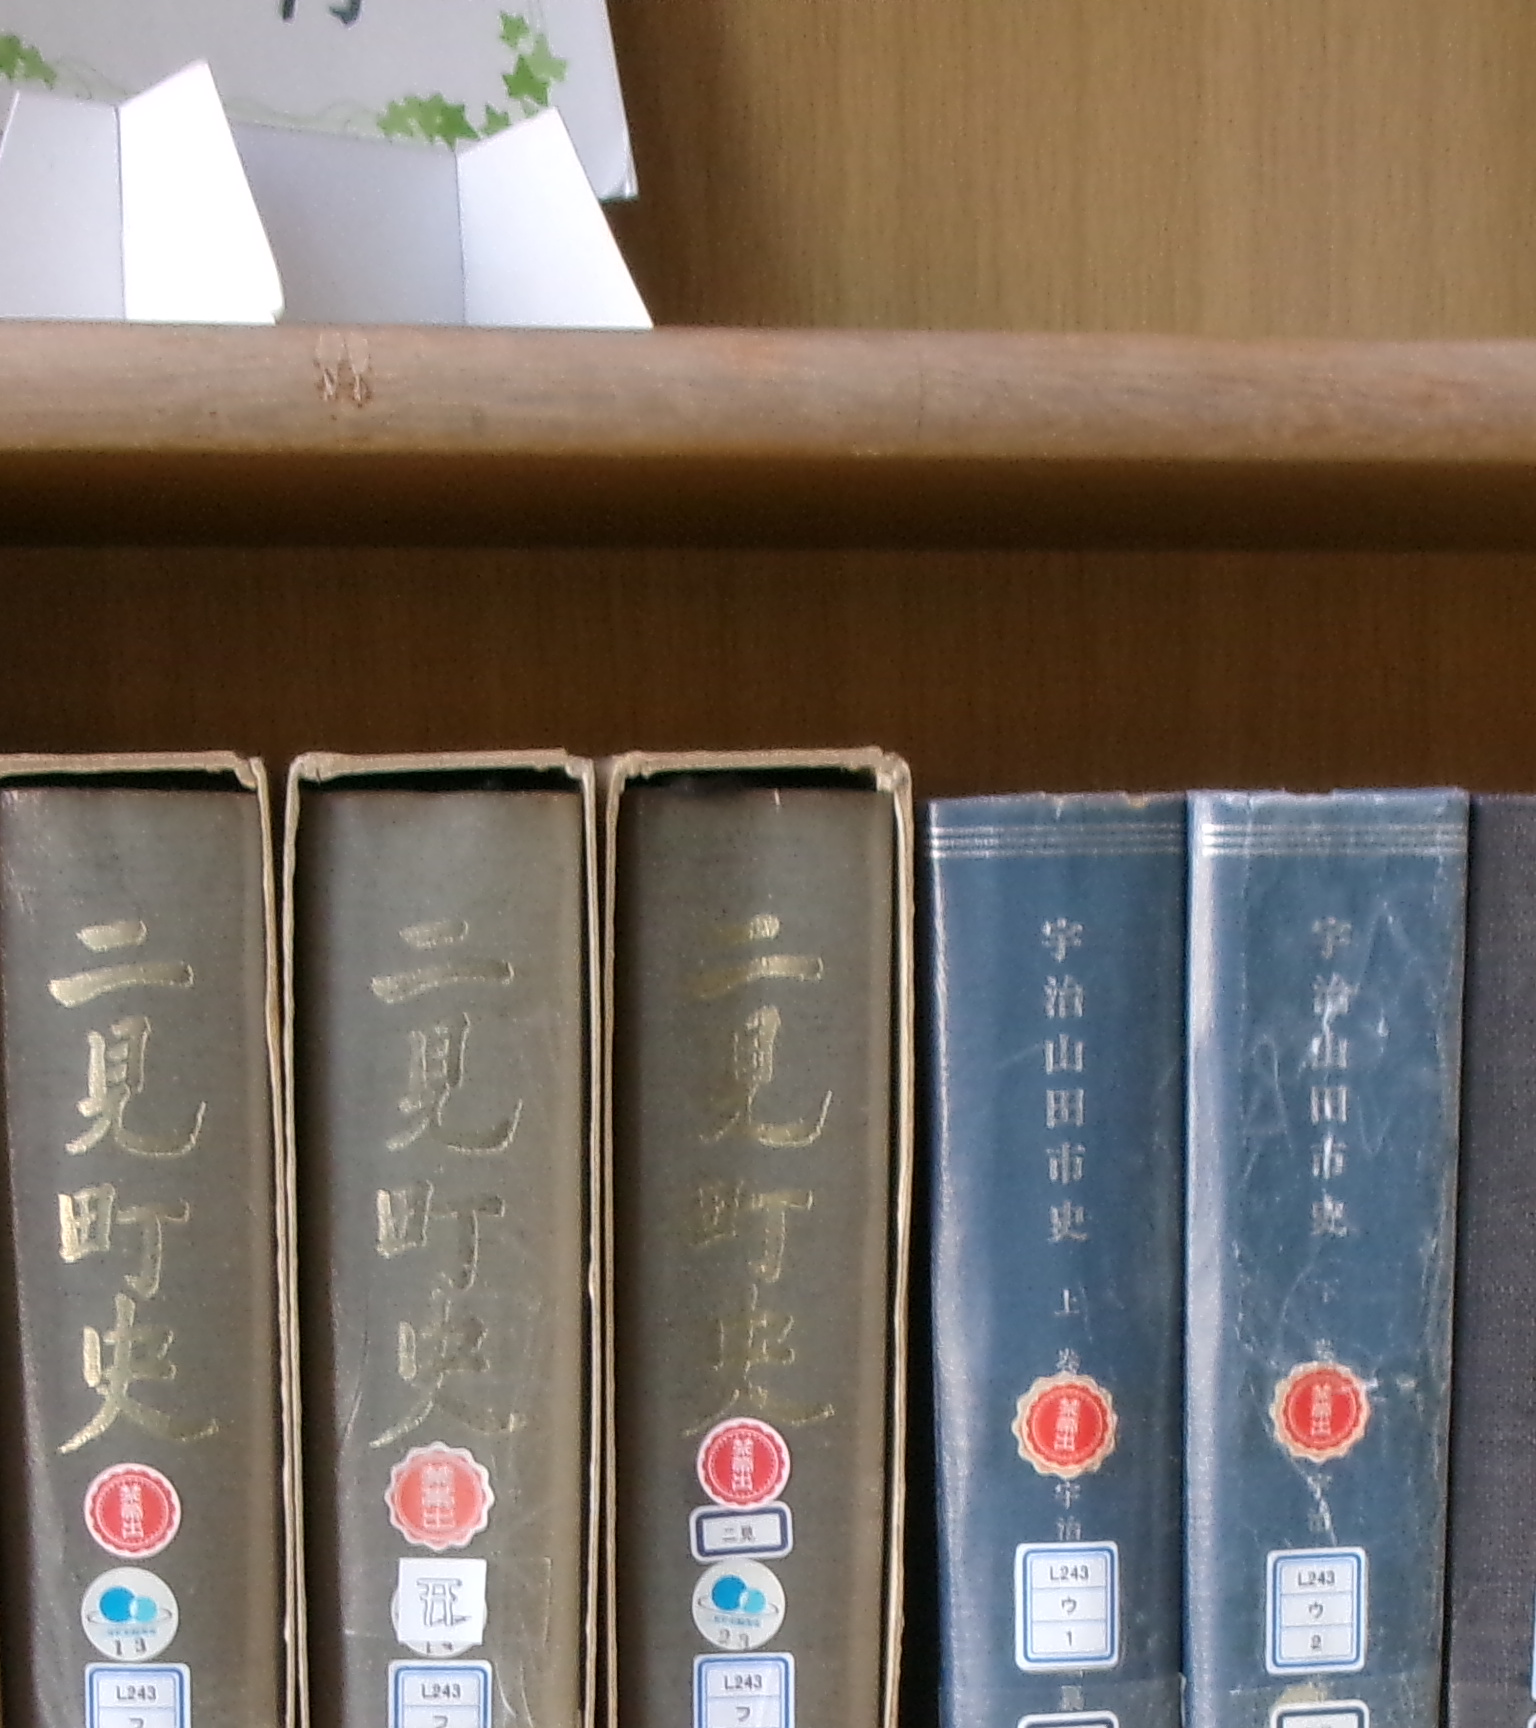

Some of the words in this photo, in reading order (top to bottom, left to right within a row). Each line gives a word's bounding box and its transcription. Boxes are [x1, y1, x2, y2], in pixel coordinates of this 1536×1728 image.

[1039, 915, 1090, 1244] 宇治山田市史
[47, 919, 221, 1454] 二見町史
[369, 918, 527, 1449] 二見町史
[1048, 1563, 1091, 1583] L243
[1297, 1567, 1337, 1588] L243
[420, 1681, 464, 1701] L243
[722, 1673, 764, 1692] L243
[115, 1683, 159, 1705] L243
